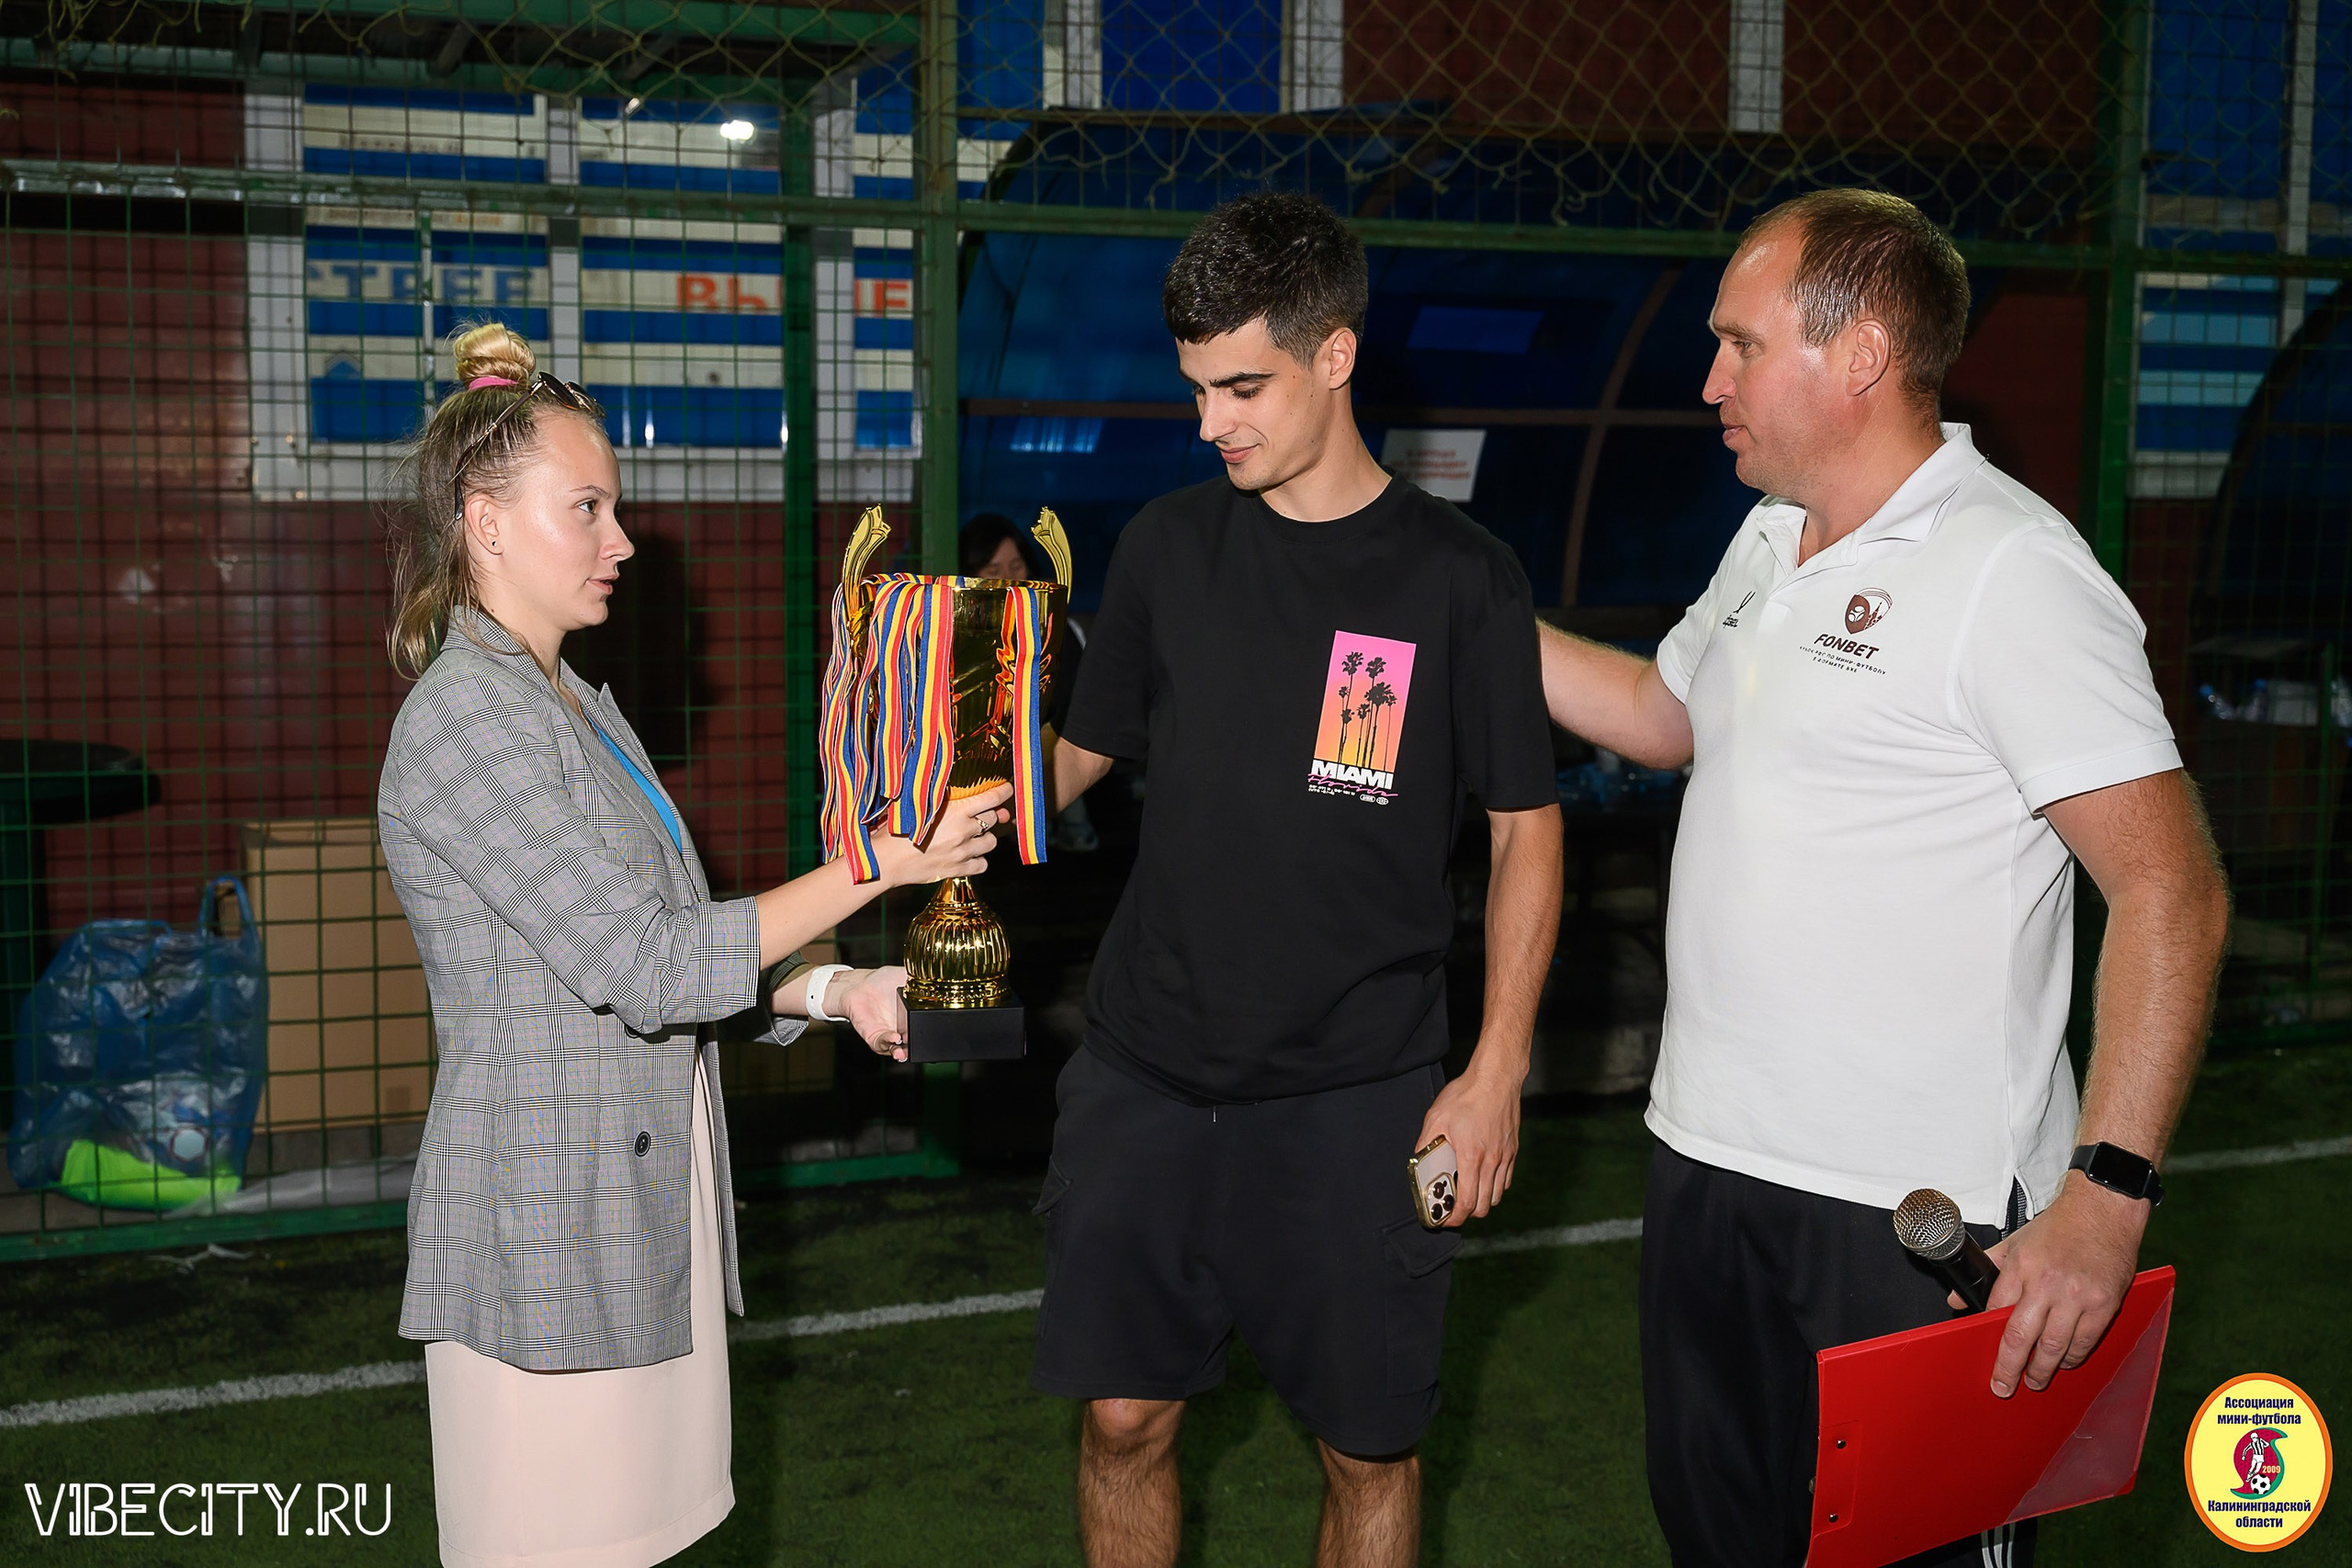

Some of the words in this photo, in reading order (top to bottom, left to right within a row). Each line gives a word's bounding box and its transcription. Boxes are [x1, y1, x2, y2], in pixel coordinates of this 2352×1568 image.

[1814, 633, 1880, 660] FONBET
[1307, 773, 1398, 797] Florida
[1310, 760, 1394, 790] MIAMI
